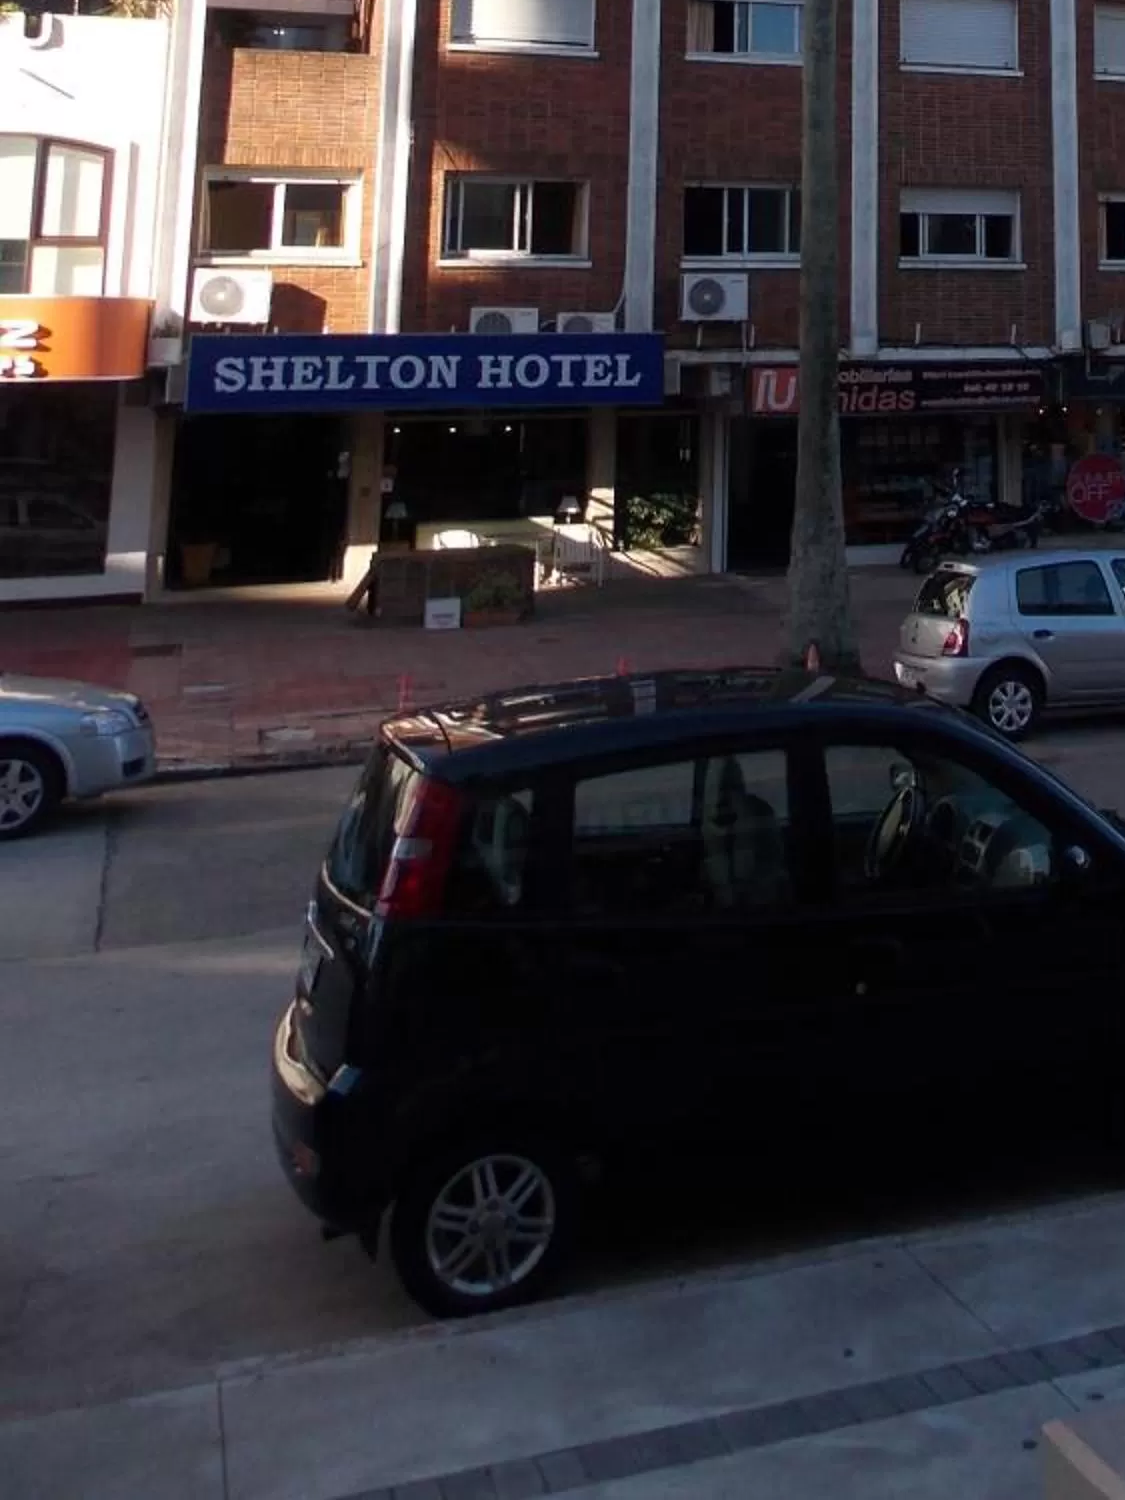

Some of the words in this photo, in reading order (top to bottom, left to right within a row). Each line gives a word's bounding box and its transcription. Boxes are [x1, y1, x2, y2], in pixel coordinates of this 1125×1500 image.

[213, 354, 462, 394] SHELTON
[477, 353, 642, 389] HOTEL
[837, 384, 917, 412] nidas
